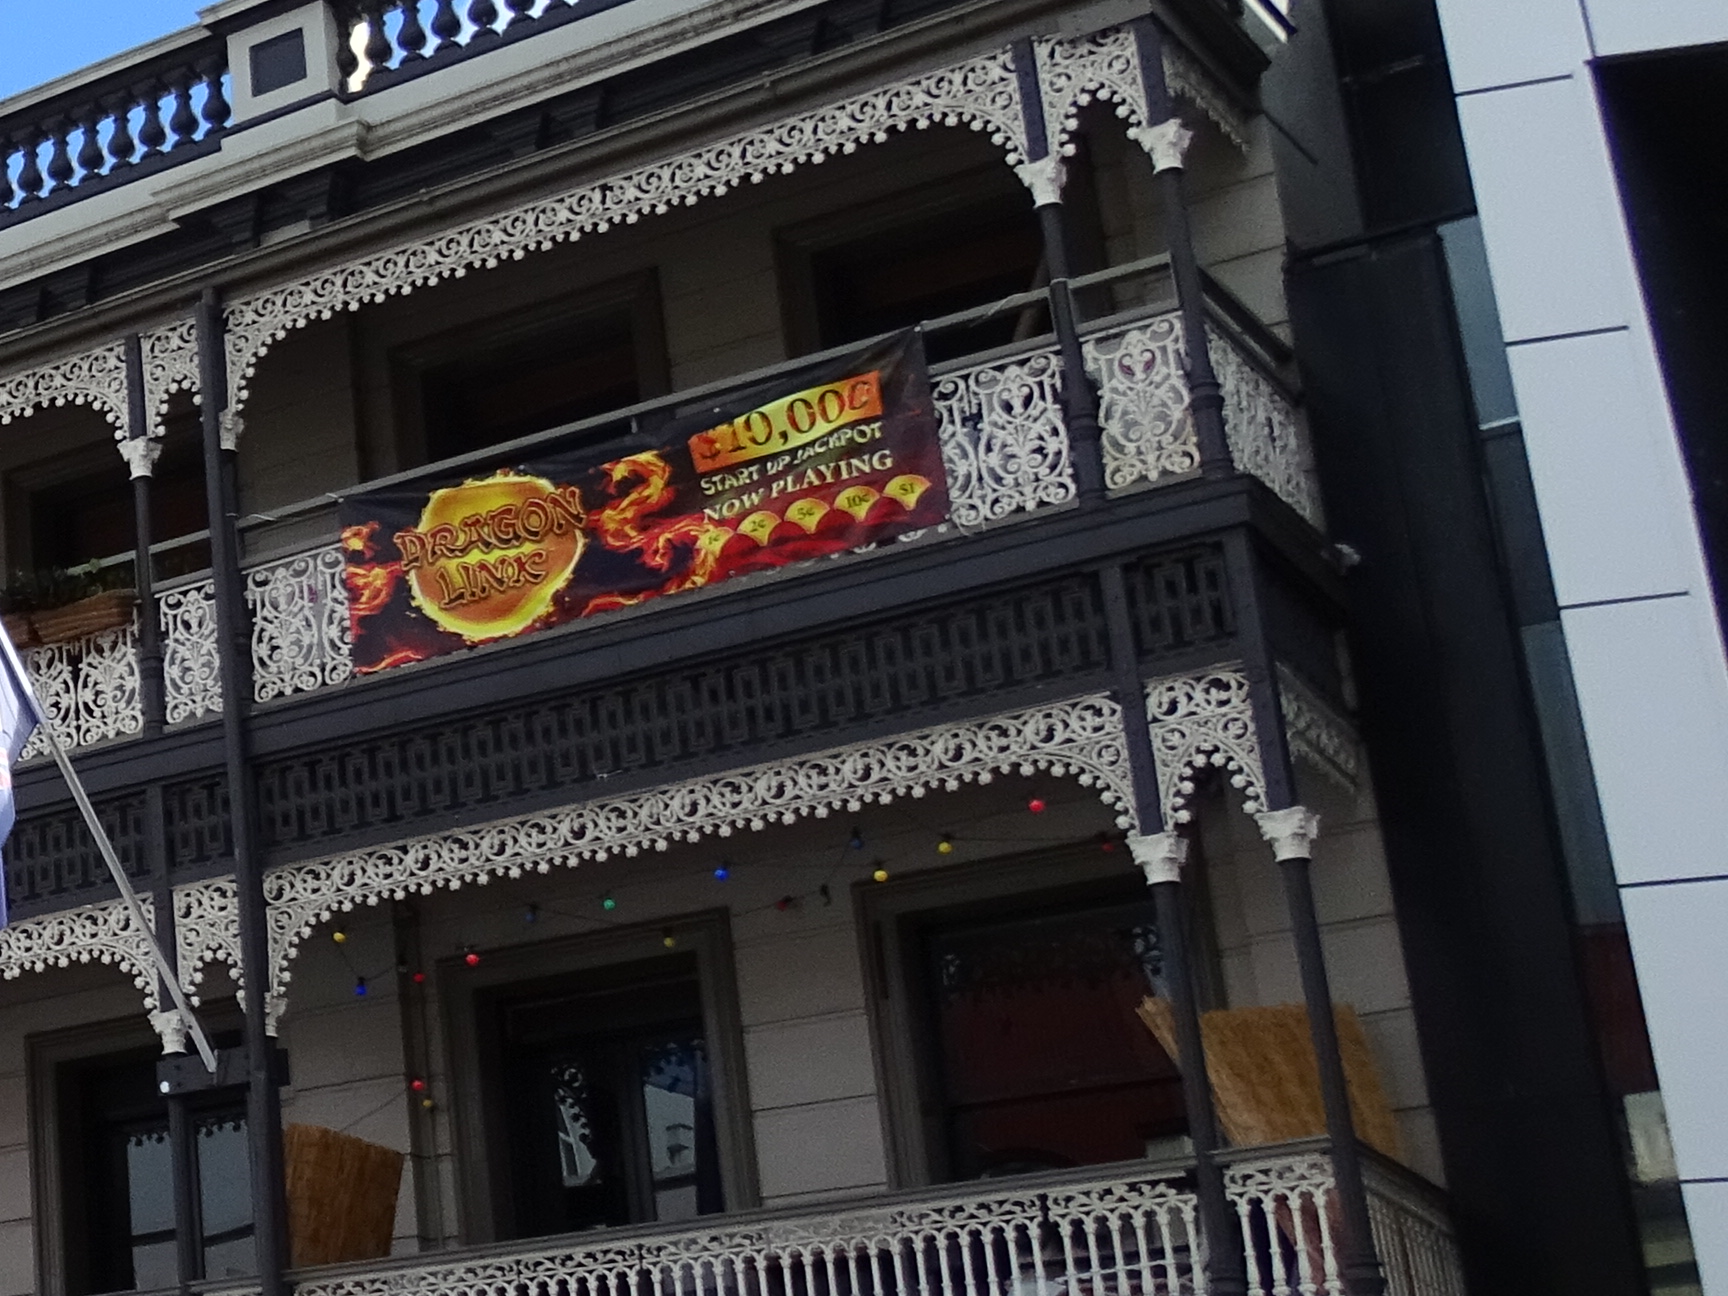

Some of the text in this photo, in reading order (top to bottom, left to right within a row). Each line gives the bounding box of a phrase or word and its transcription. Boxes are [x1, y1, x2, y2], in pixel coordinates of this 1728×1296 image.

[700, 421, 883, 495] START UP JACKPOT
[704, 449, 894, 521] NOW PLAYING
[394, 487, 587, 571] DRAGON
[437, 550, 547, 609] LINK
